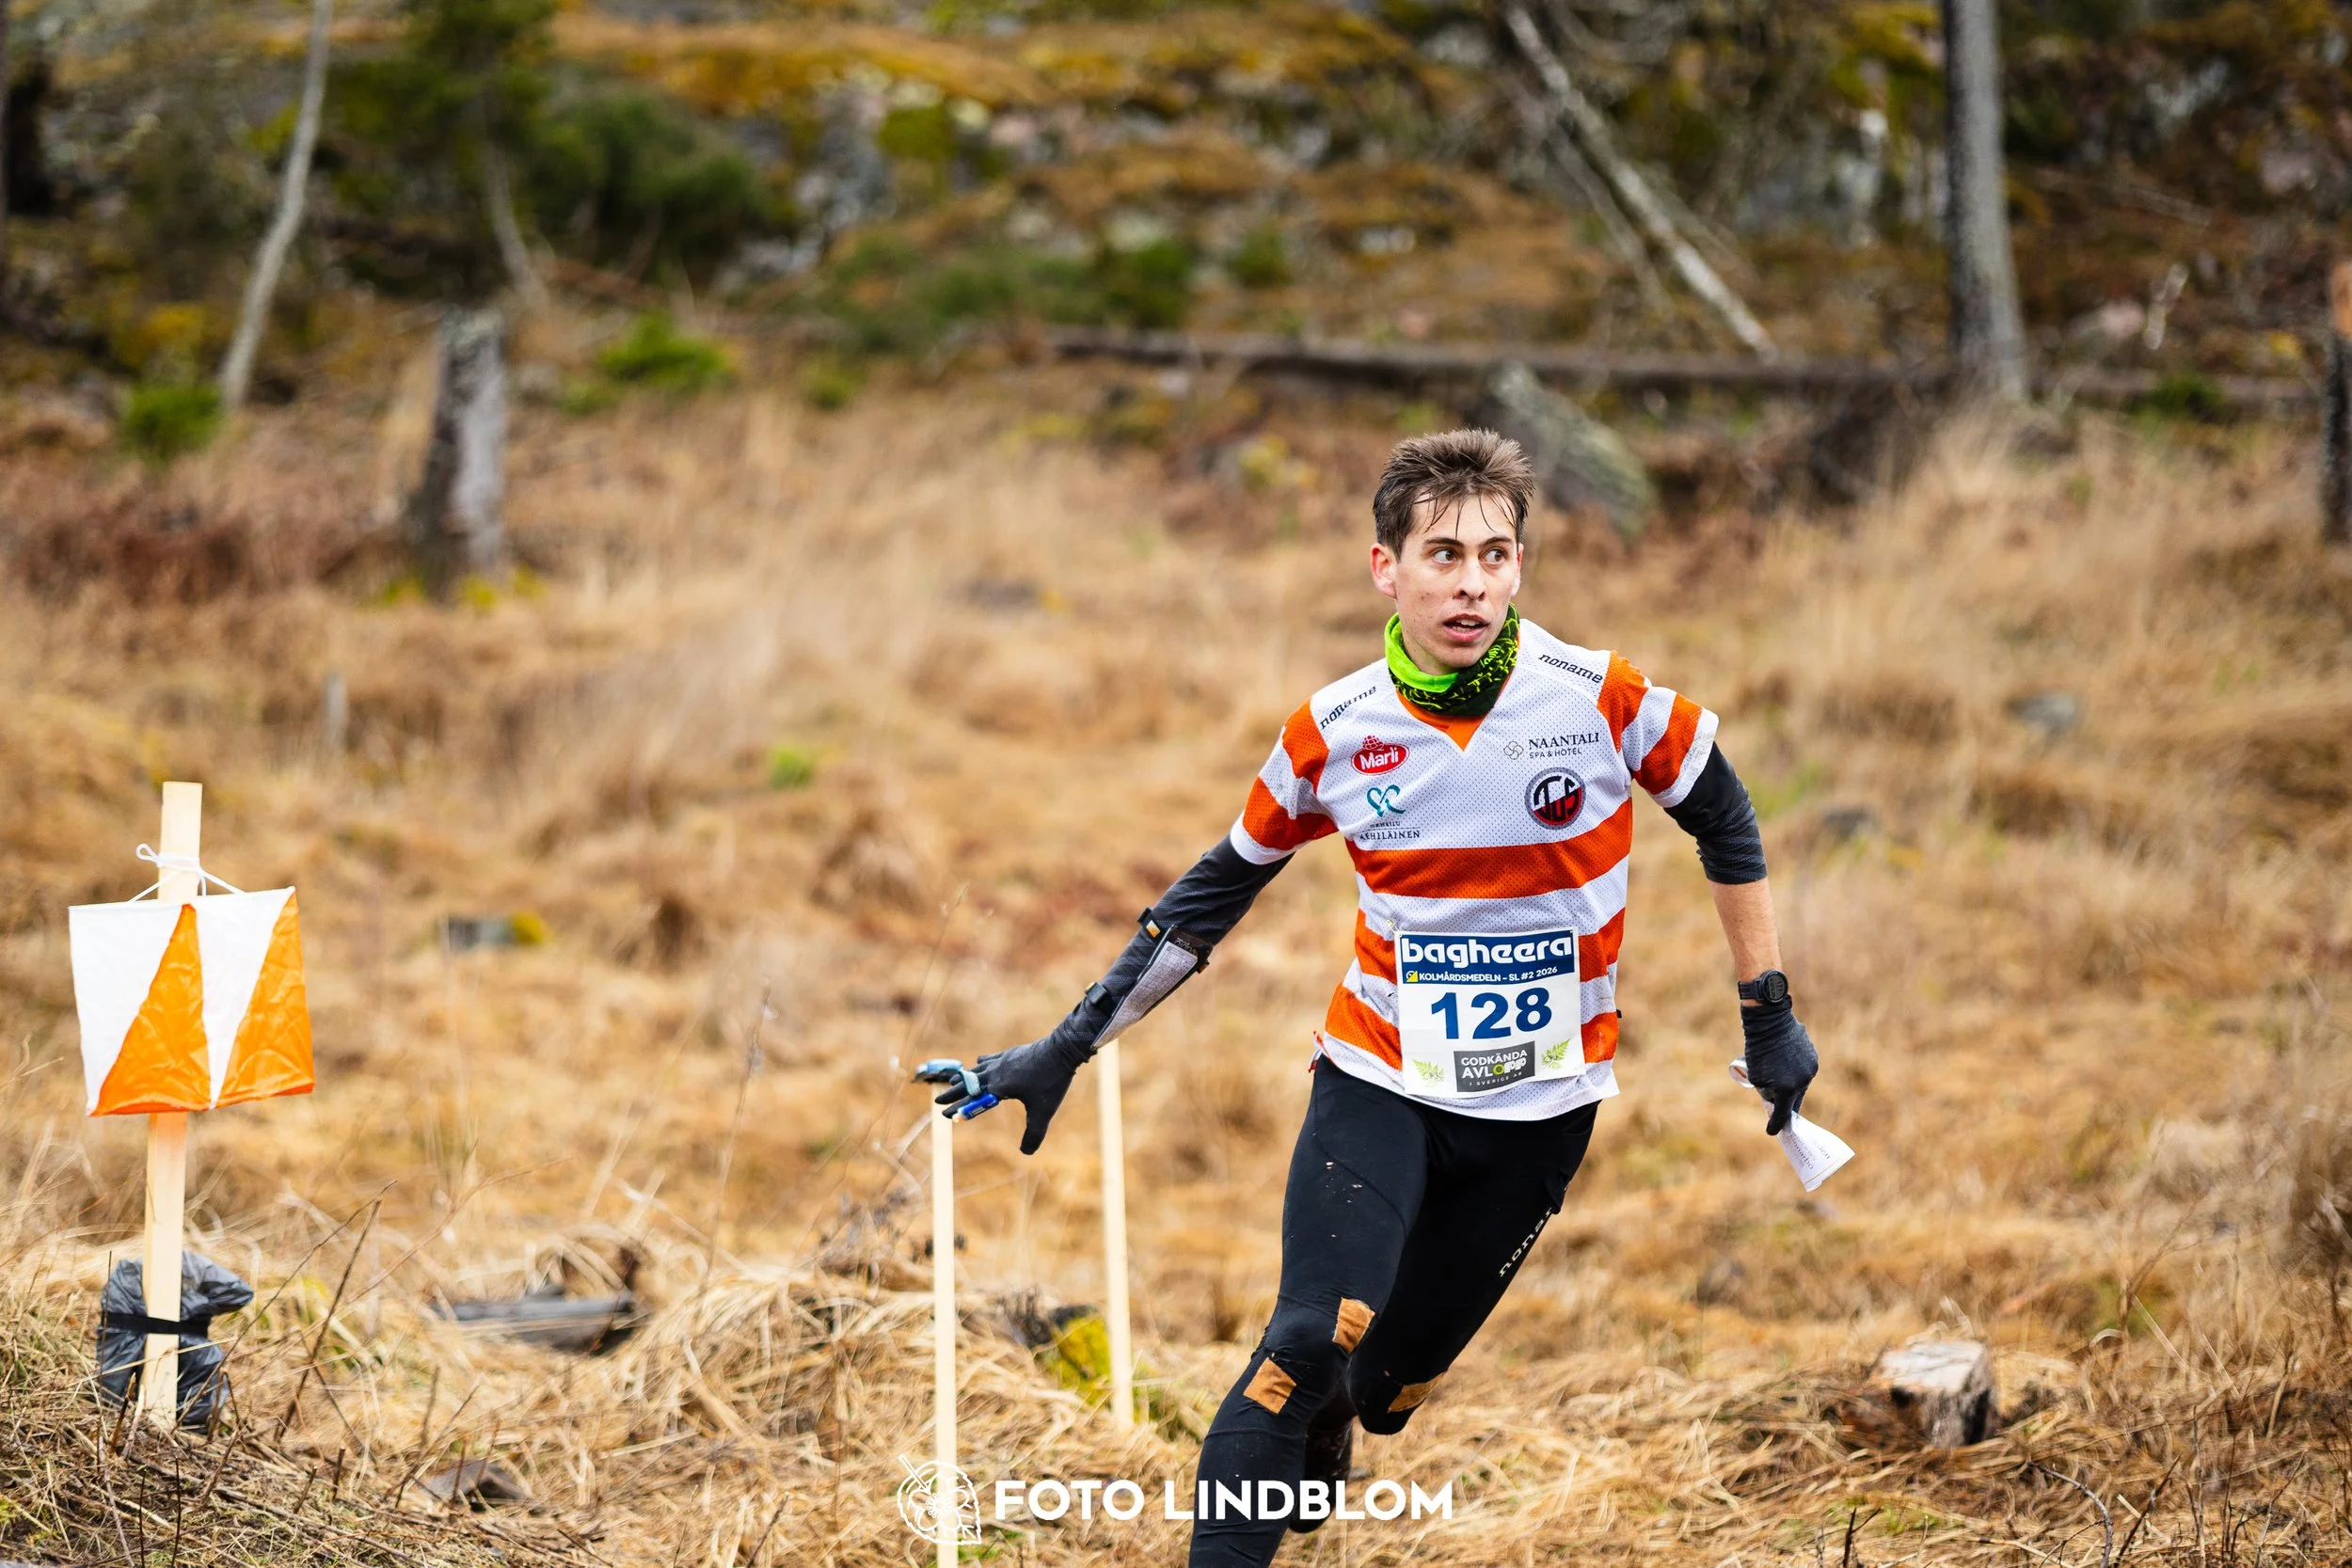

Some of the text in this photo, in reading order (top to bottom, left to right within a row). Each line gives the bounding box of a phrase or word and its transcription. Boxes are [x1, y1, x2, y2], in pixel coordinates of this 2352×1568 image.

[1538, 654, 1603, 683] noname
[1320, 686, 1376, 730] noname
[1529, 732, 1599, 750] NAANTALI
[1554, 747, 1582, 756] HOTEL
[1359, 746, 1399, 770] Marli
[1402, 938, 1572, 968] bagheera
[1419, 970, 1502, 982] KOLMÅRDSMEDELN
[1508, 973, 1520, 981] SL
[1520, 971, 1534, 980] #2
[1535, 966, 1558, 977] 2026
[1431, 987, 1552, 1039] 128
[1461, 1050, 1528, 1067] GODKÄNDA
[1461, 1057, 1527, 1079] AVLOPP
[1476, 1076, 1509, 1086] SVERIGE
[1499, 1206, 1552, 1277] nona
